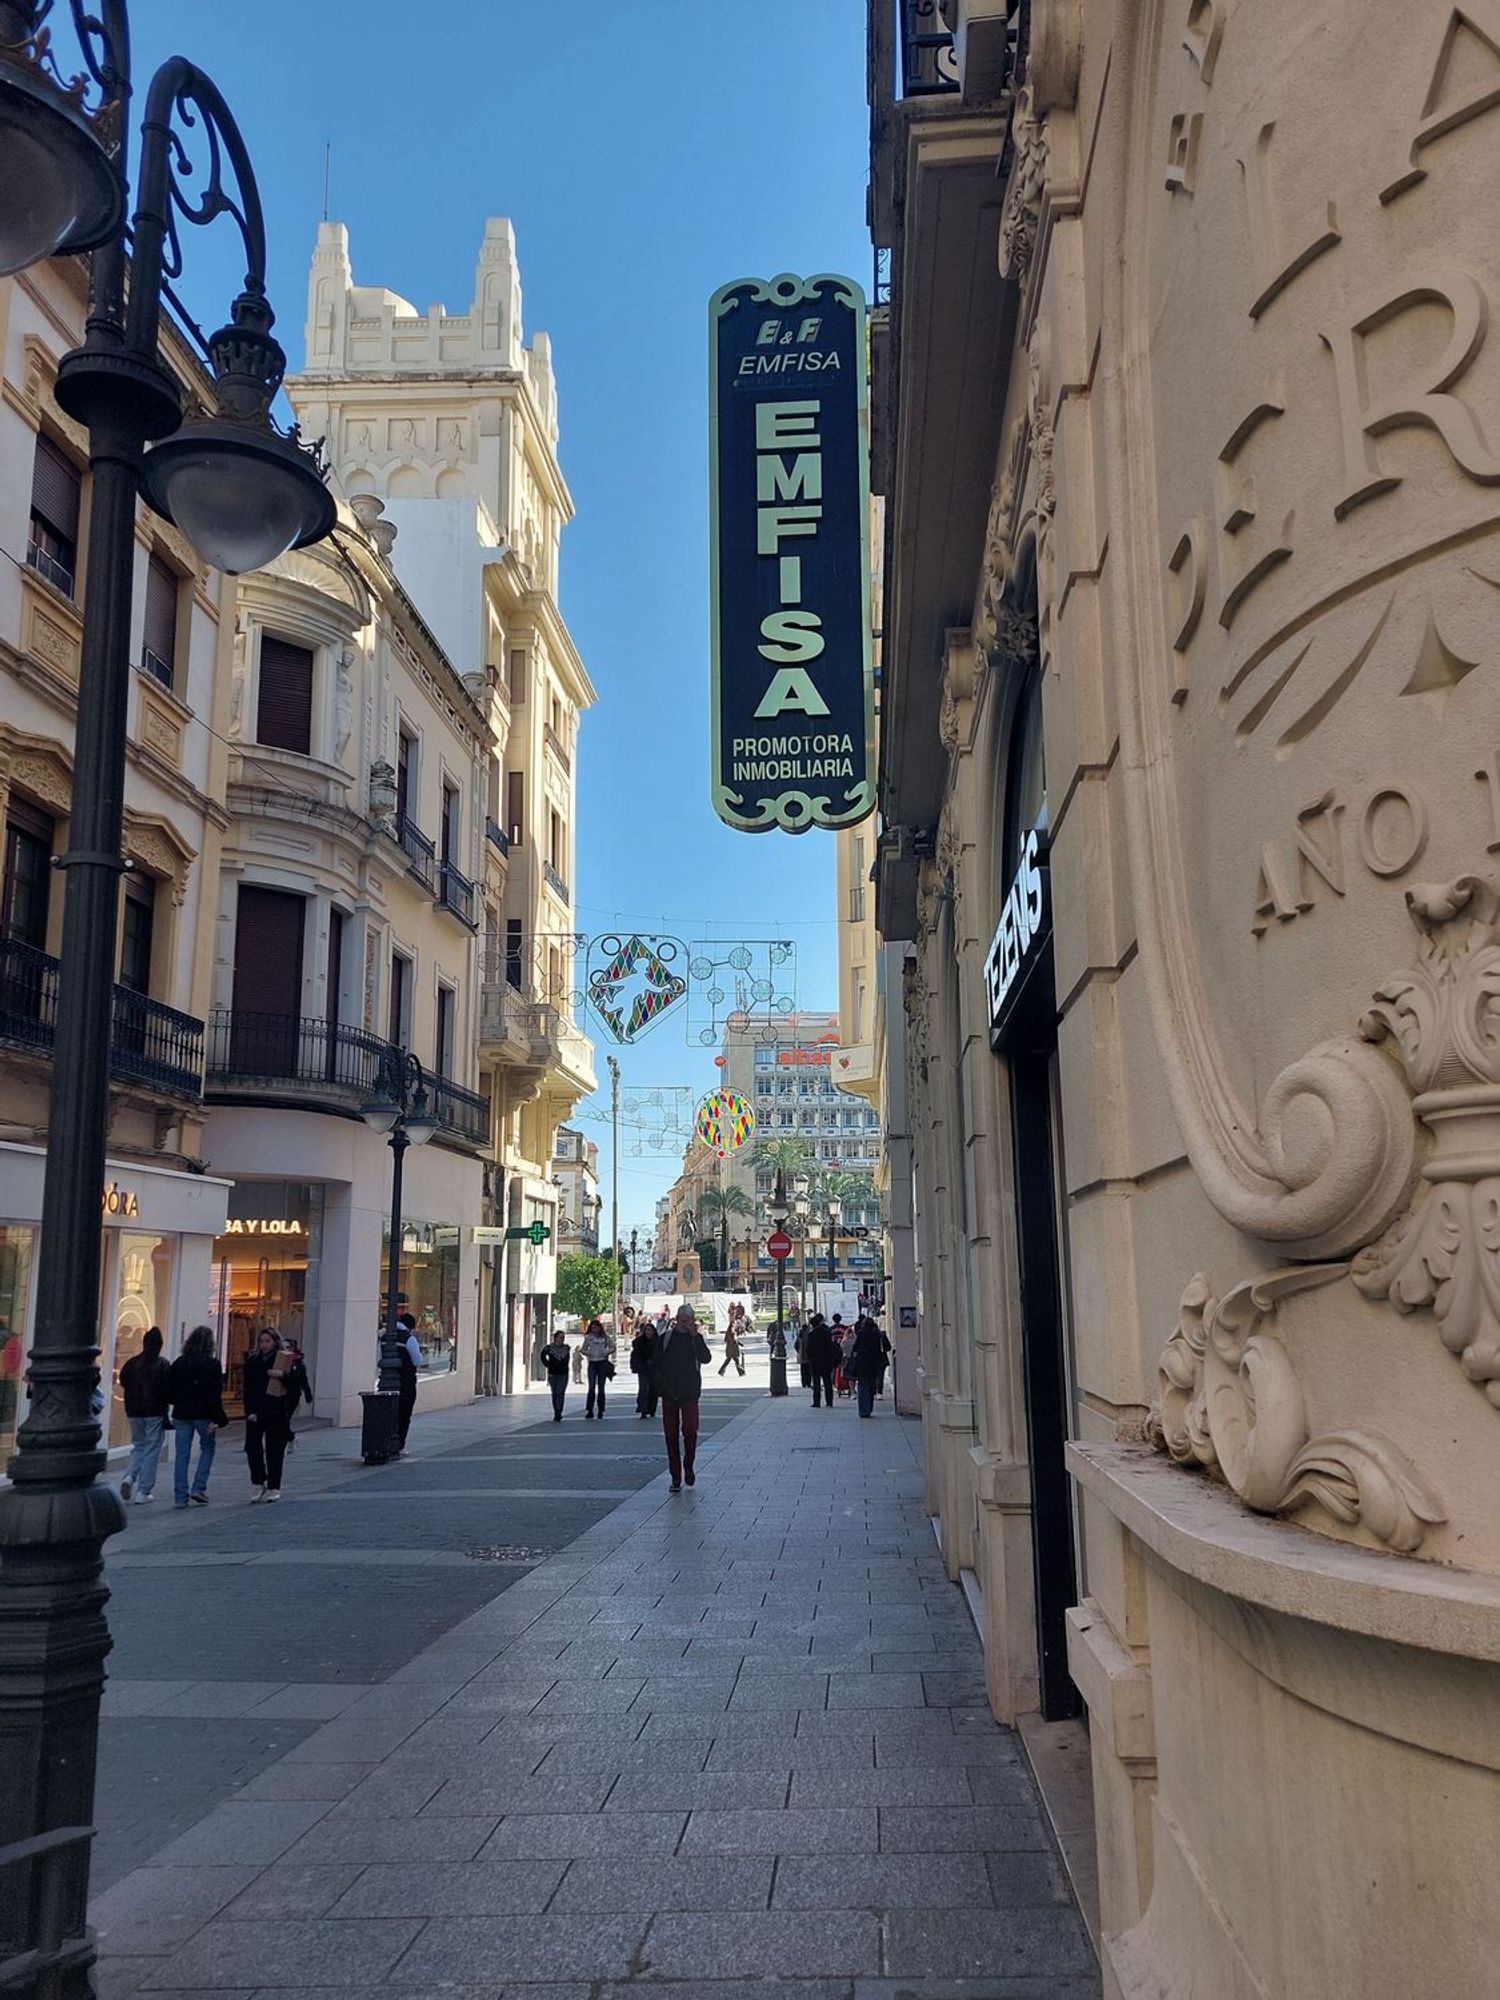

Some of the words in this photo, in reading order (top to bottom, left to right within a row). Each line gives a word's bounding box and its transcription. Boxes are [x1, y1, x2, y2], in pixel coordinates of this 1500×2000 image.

[739, 351, 841, 375] EMFISA
[754, 400, 831, 717] EMFISA
[733, 734, 853, 757] PROMOTORA
[733, 758, 854, 781] INMOBILIARIA
[984, 829, 1042, 1028] TEZENIS
[246, 1219, 258, 1234] Y
[261, 1219, 302, 1234] LOLA
